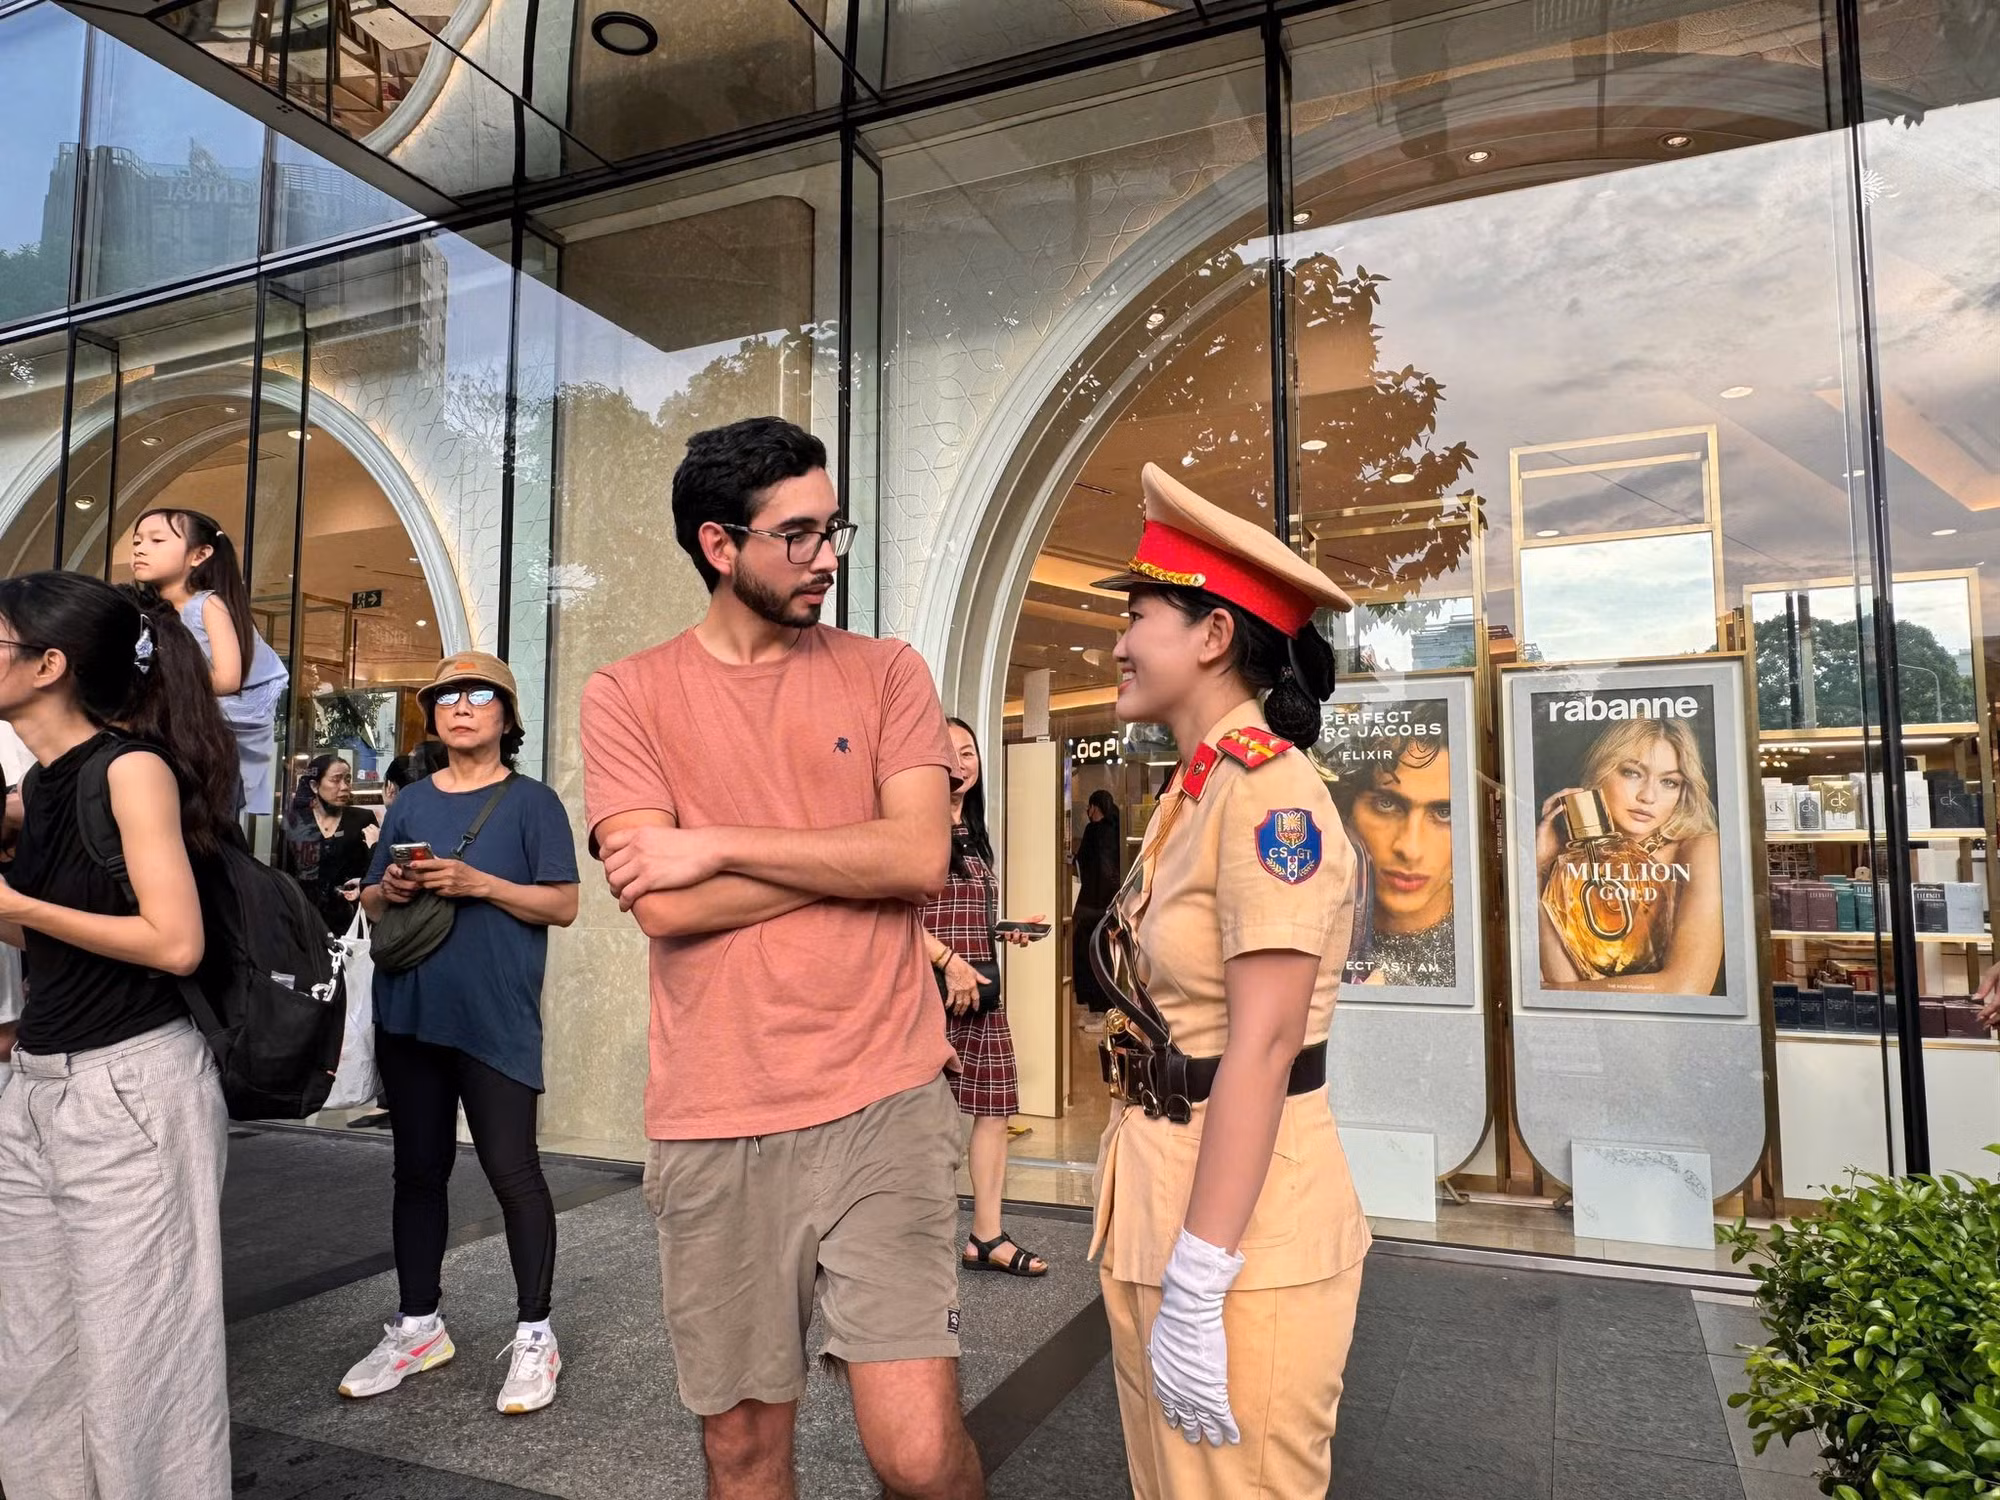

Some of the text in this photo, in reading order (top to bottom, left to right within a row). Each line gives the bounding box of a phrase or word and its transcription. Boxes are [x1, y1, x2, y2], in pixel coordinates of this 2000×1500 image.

[1549, 695, 1699, 722] rabanne
[1322, 710, 1412, 726] PERFECT
[1319, 723, 1442, 740] RC JACOBS
[1342, 749, 1393, 761] ELIXIR
[1565, 862, 1692, 883] MILLION
[1599, 886, 1658, 902] GOLD
[1346, 961, 1375, 971] ECT
[1379, 961, 1400, 972] AS
[1417, 963, 1439, 973] AM
